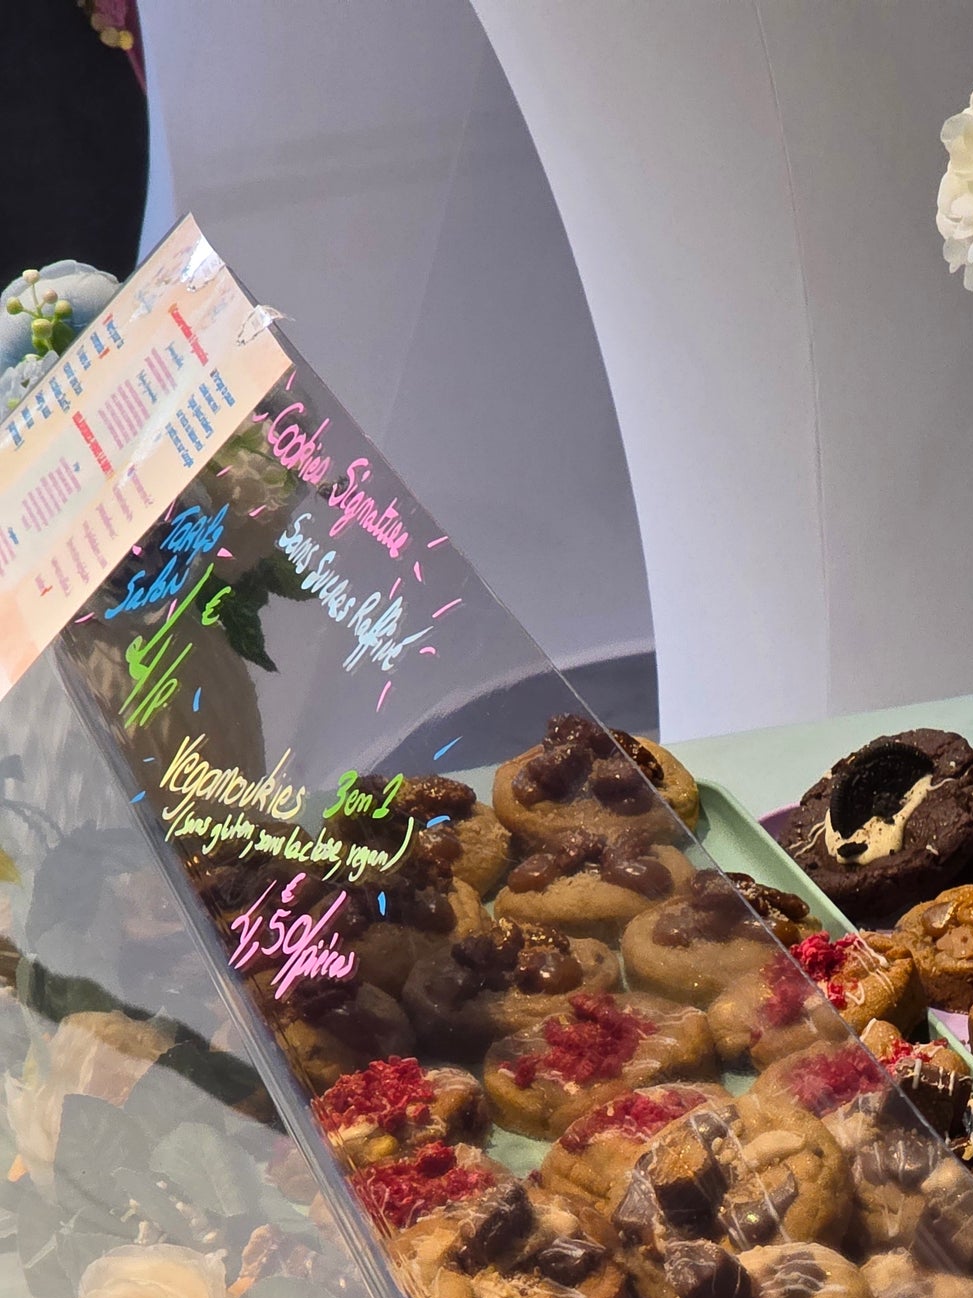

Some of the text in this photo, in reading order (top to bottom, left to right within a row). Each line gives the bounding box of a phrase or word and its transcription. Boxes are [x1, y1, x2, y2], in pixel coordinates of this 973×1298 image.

[268, 402, 331, 484] Cookies
[328, 457, 409, 559] Signature
[278, 512, 319, 574] Sans
[301, 550, 356, 622] Sucres
